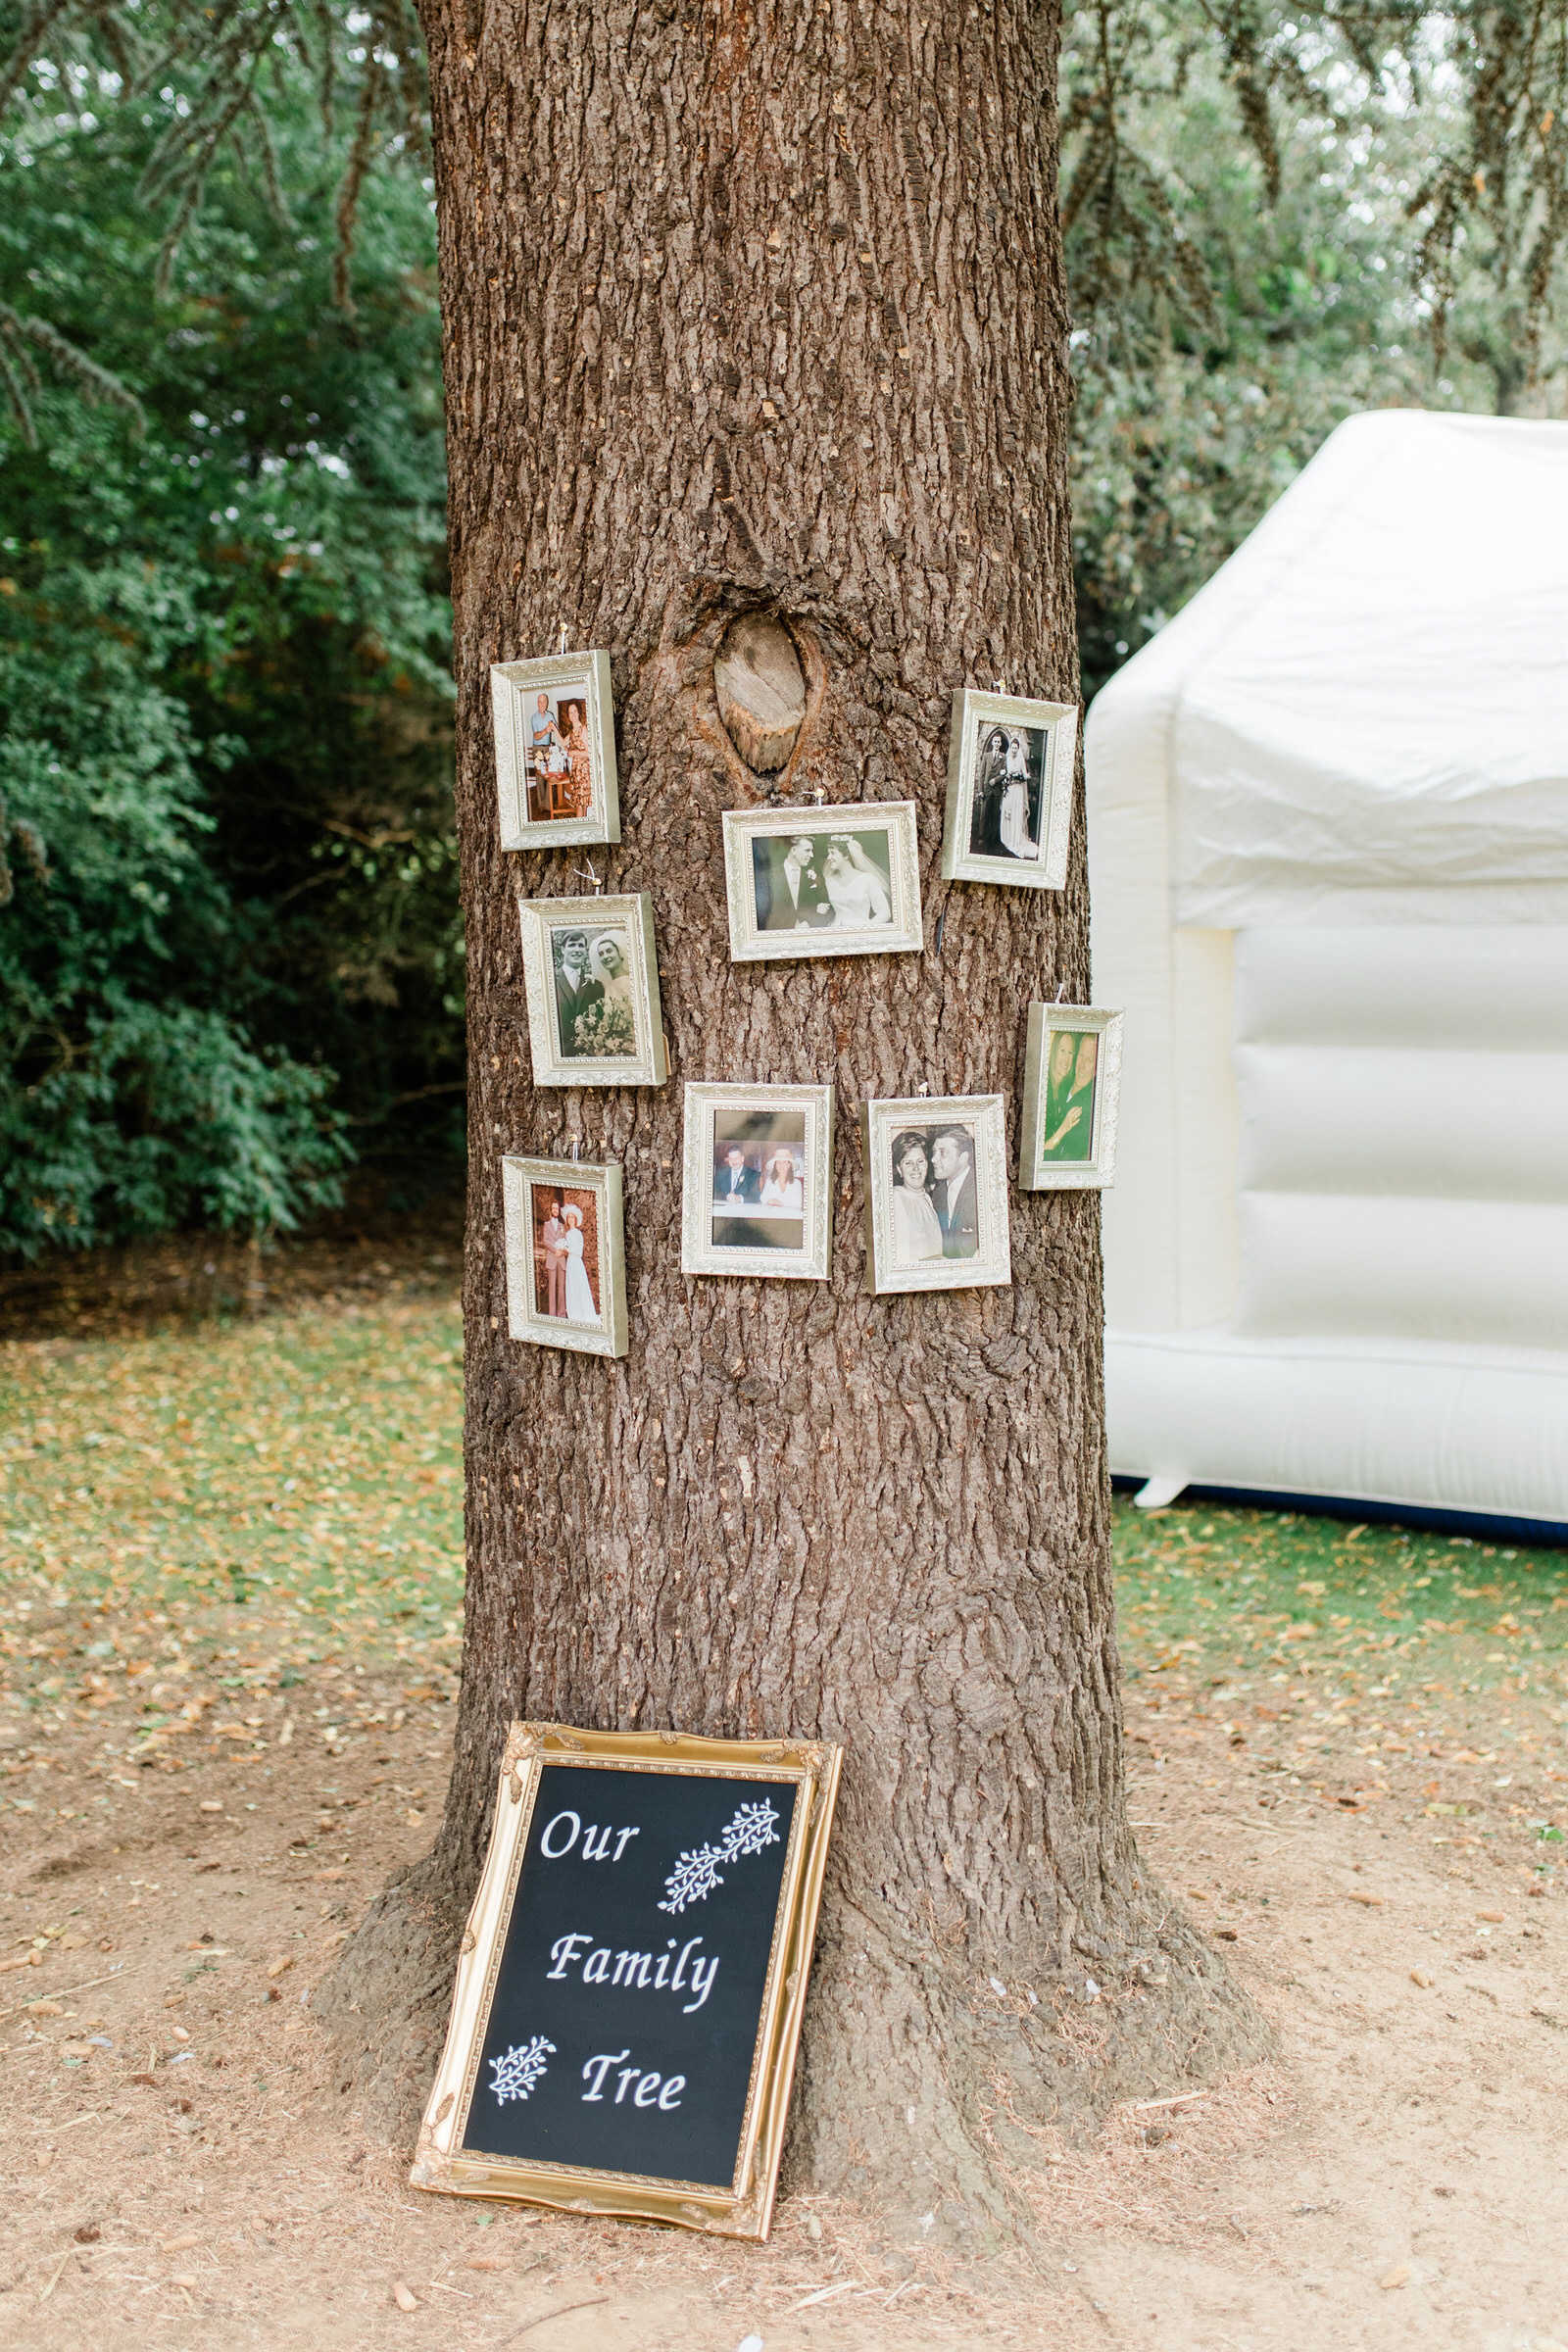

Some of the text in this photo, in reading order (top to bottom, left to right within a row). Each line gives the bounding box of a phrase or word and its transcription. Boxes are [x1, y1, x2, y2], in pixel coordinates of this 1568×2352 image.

[540, 1810, 641, 1862] Our
[546, 1932, 719, 2014] Family
[581, 2048, 687, 2111] Tree
